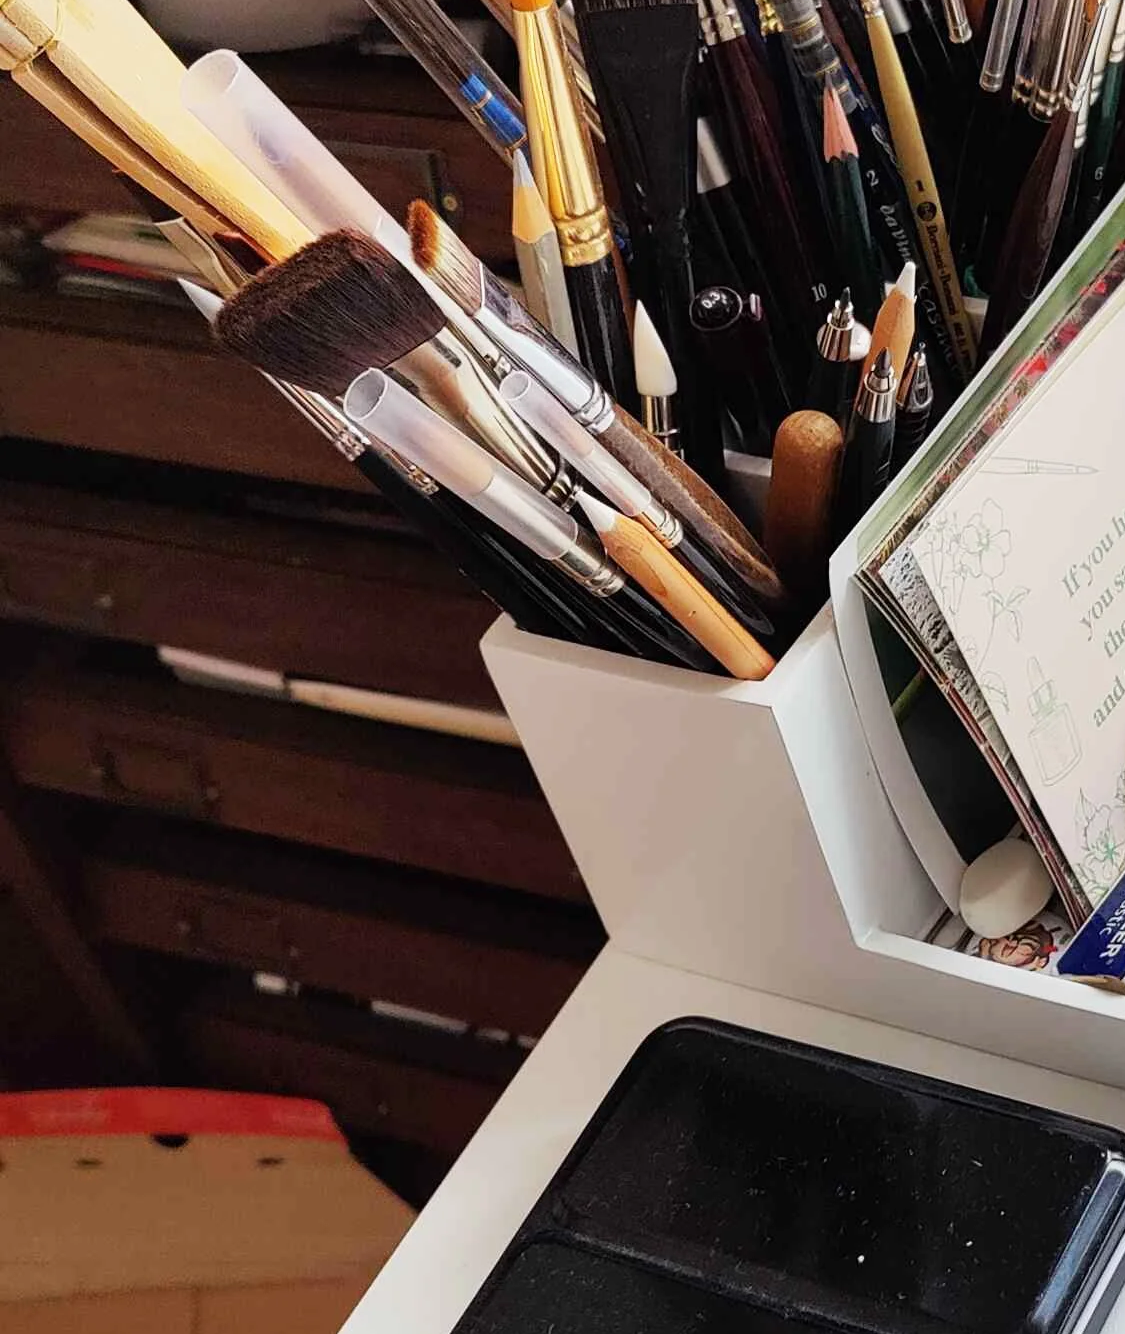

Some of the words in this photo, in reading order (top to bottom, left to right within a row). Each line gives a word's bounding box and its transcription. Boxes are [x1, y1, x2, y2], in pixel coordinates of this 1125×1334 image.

[866, 169, 880, 187] 2
[1094, 166, 1104, 181] 6
[701, 291, 721, 309] 0.3
[811, 282, 827, 302] 10
[1062, 564, 1081, 598] If
[1080, 533, 1114, 587] you
[1079, 587, 1114, 641] you
[1093, 675, 1125, 728] and
